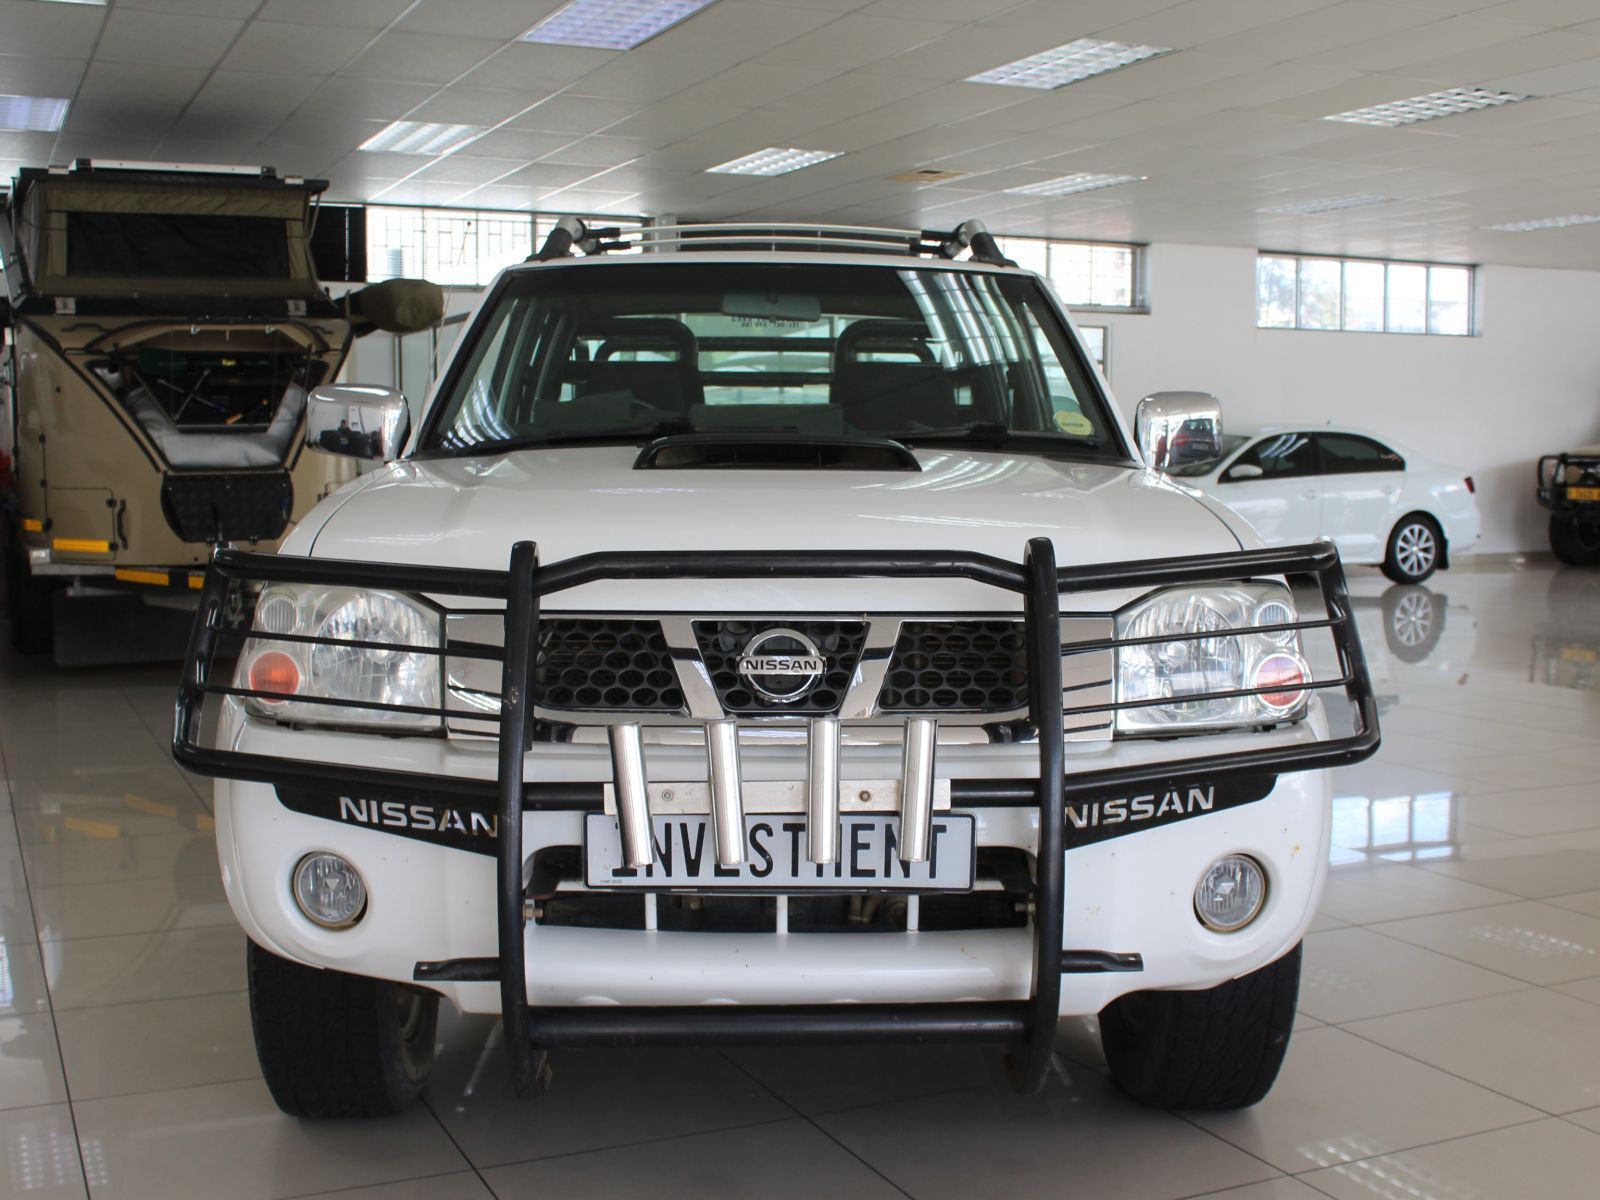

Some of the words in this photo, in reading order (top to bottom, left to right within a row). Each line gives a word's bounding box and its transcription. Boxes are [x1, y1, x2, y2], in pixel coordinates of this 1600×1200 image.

[745, 660, 817, 671] NISSAN
[338, 796, 498, 838] NISSAN
[1064, 786, 1215, 829] NISSAN
[611, 822, 948, 879] NVSTENT
